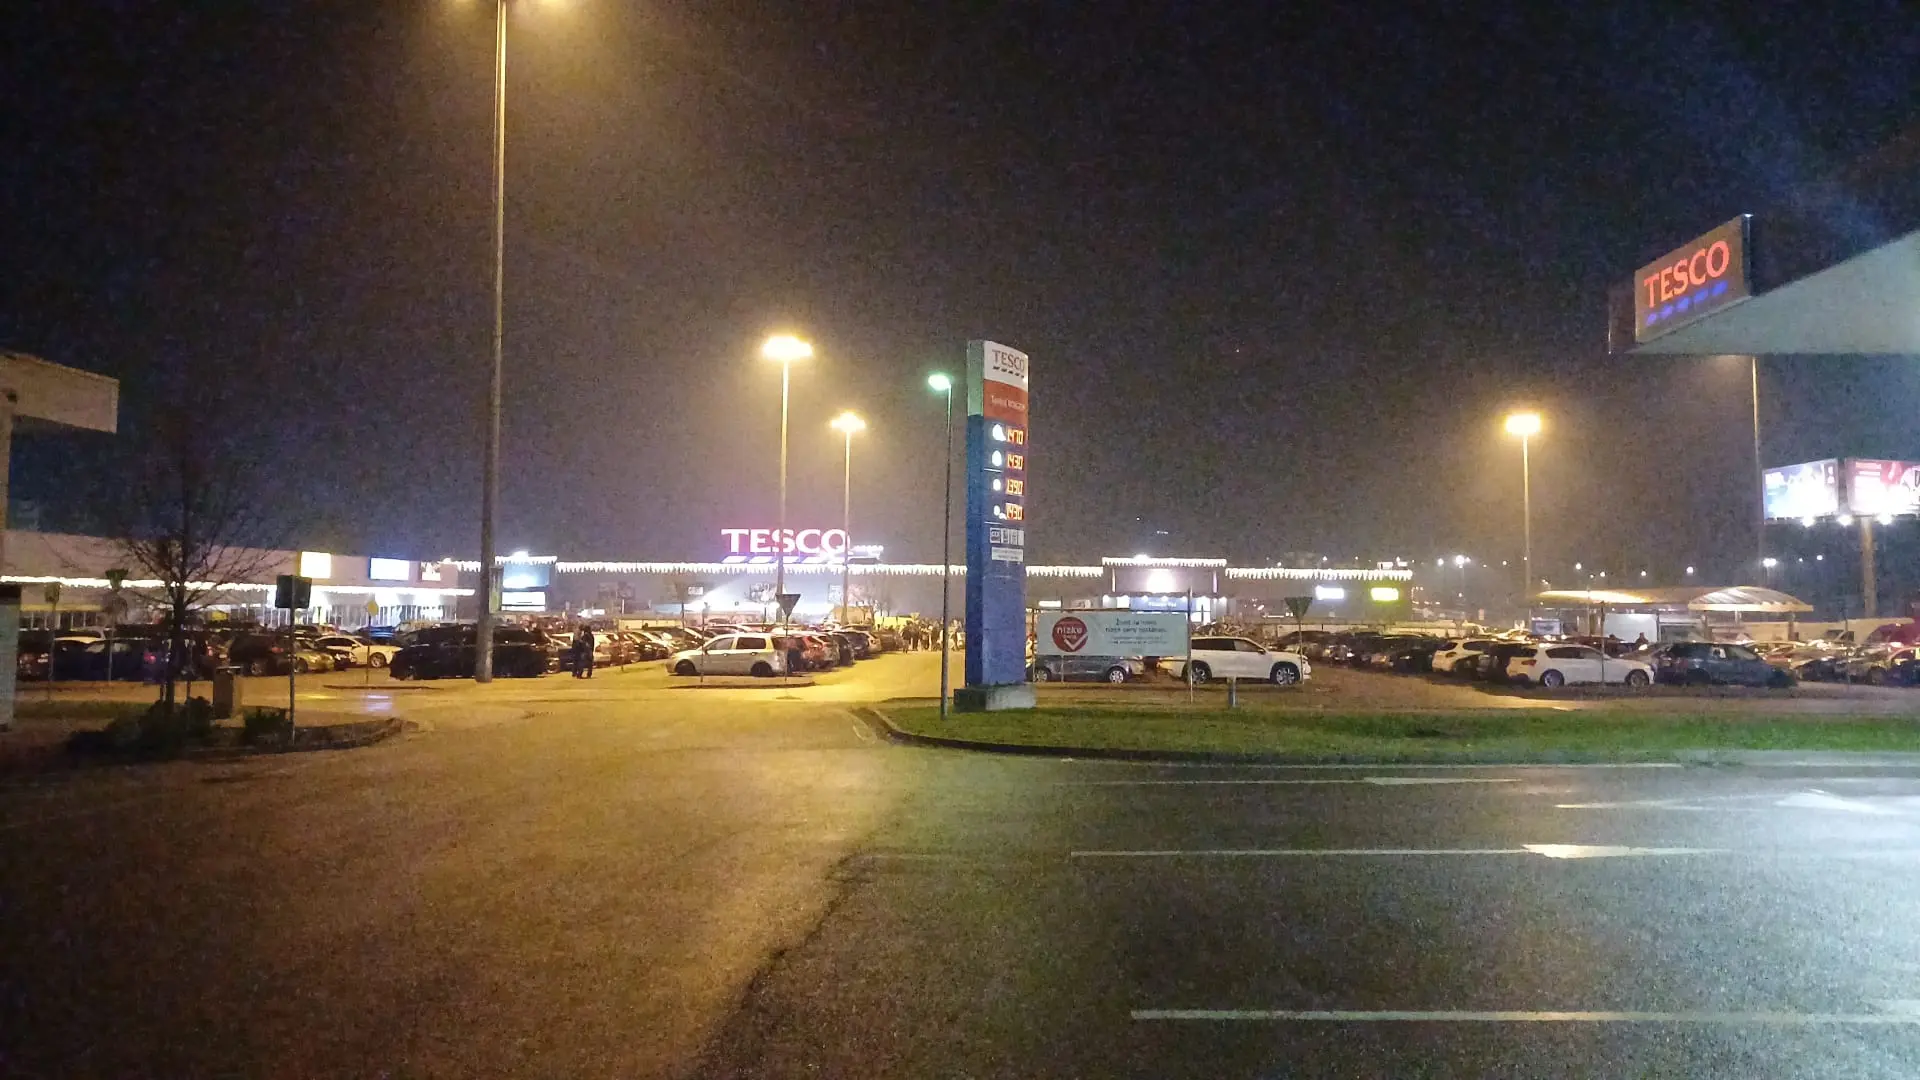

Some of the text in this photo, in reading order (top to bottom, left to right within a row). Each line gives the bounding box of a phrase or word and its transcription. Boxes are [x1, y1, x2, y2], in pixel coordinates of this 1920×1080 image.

[1643, 240, 1730, 309] TESCO
[992, 349, 1025, 373] TESCO
[721, 528, 850, 554] TESCO
